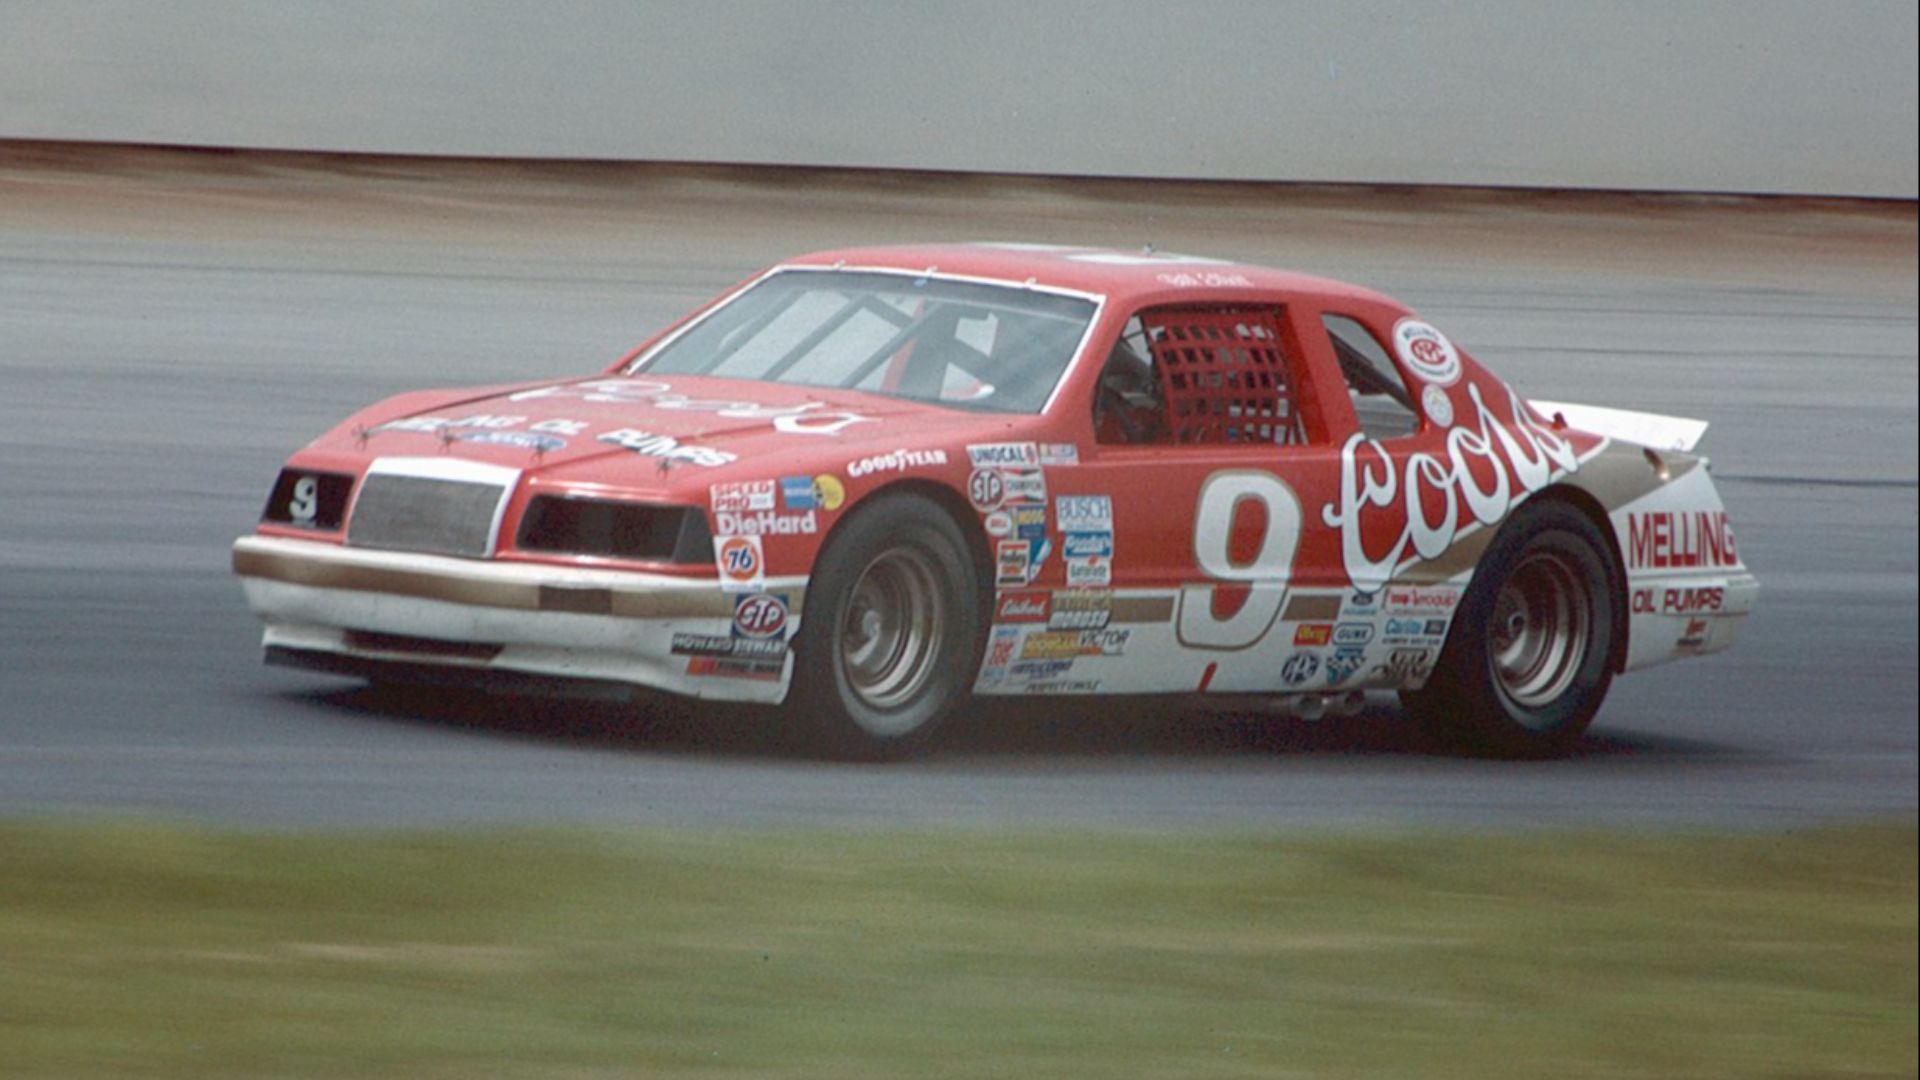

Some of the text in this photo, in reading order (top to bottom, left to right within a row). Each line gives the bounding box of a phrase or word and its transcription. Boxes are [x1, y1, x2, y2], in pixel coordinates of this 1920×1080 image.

[847, 449, 947, 477] GOODYEAR
[288, 477, 318, 520] 9
[714, 480, 770, 496] SPEED
[972, 470, 1001, 502] STP
[1322, 382, 1584, 594] Coors
[715, 495, 750, 509] PRO
[1059, 497, 1110, 518] BUSCH
[716, 510, 818, 535] DieHard
[1628, 511, 1738, 569] MELLING
[728, 547, 753, 570] 76
[1176, 468, 1304, 652] 9
[1632, 586, 1724, 614] OIL PUMPS
[739, 600, 781, 629] STP
[1079, 628, 1131, 647] VICTOR
